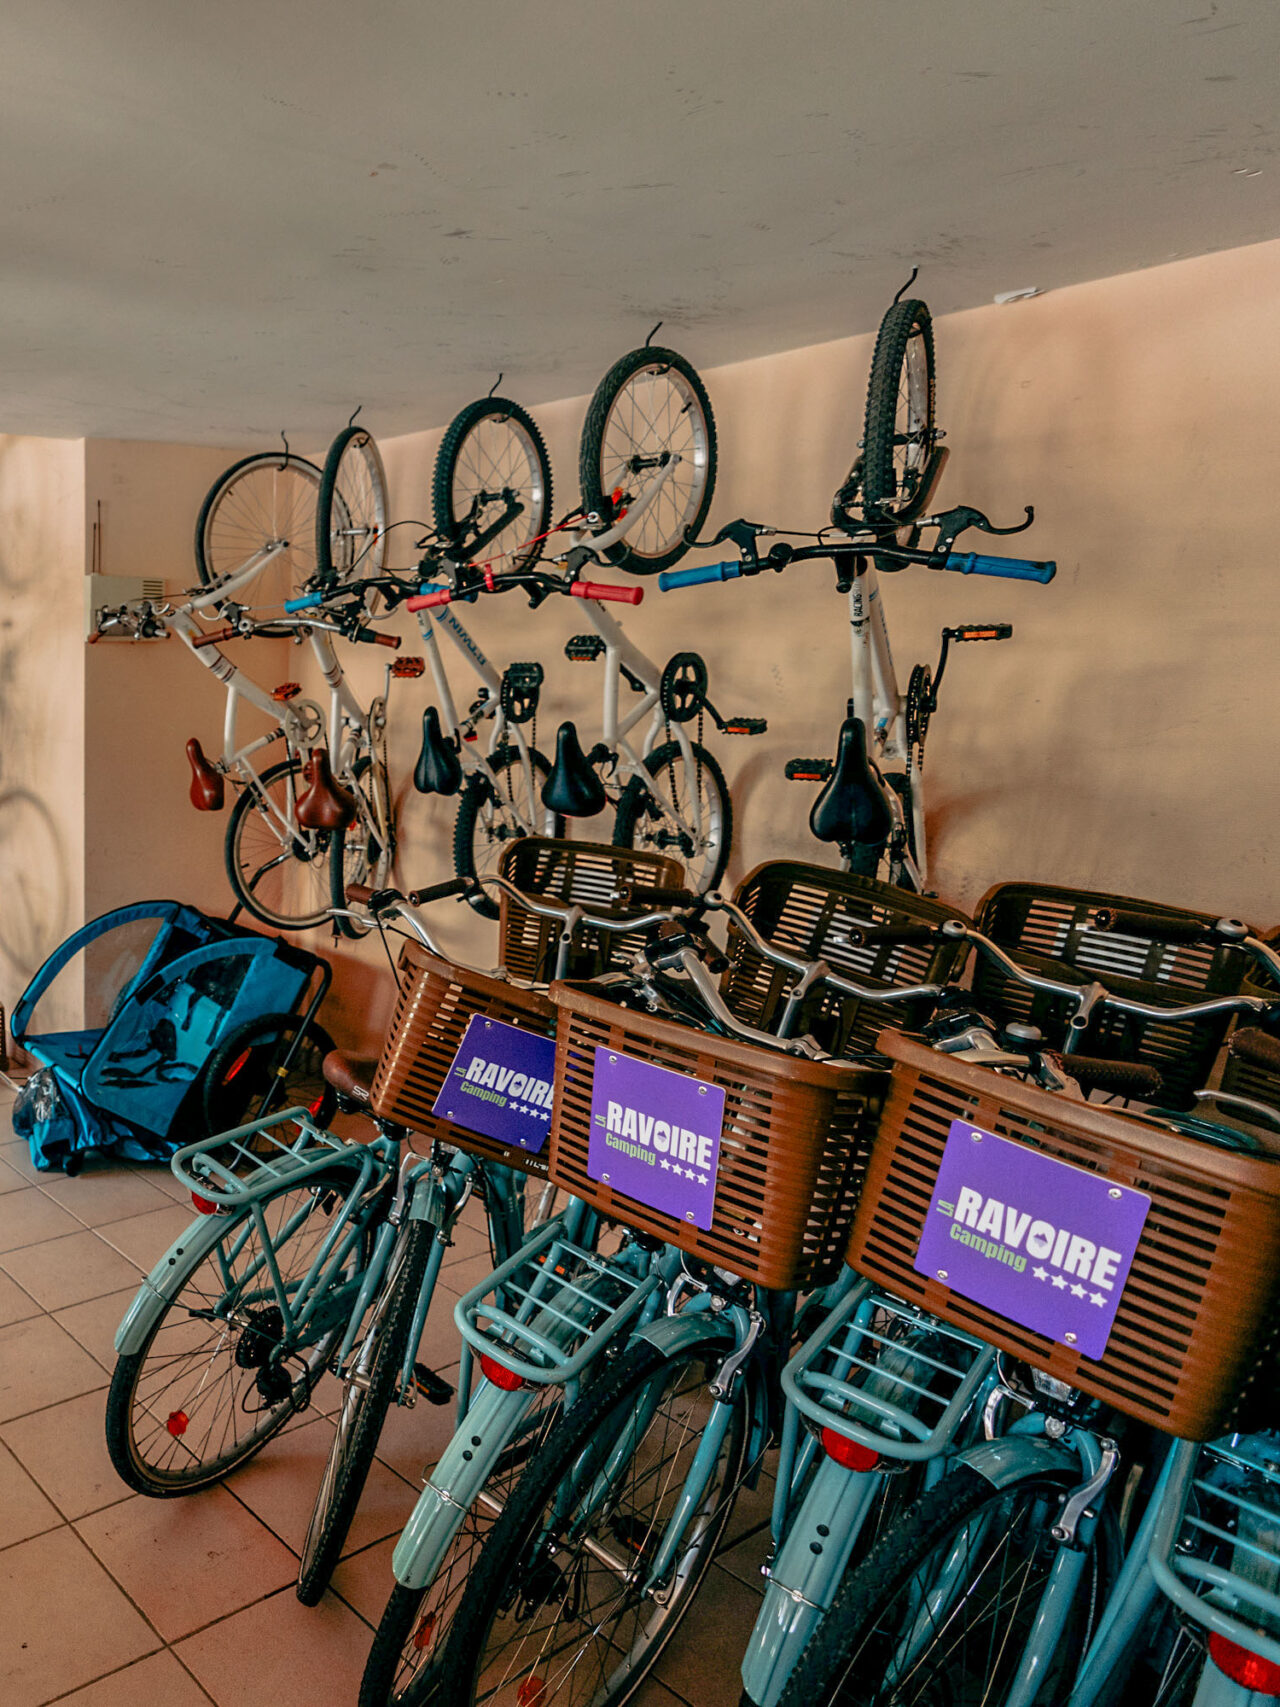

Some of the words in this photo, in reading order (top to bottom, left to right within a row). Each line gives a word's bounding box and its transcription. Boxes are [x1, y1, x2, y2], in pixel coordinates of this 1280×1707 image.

[460, 1081, 507, 1107] Camping
[605, 1132, 657, 1167] Camping
[606, 1100, 714, 1171] RAVOIRE
[950, 1223, 1028, 1273] Camping
[953, 1186, 1122, 1291] RAVOIRE
